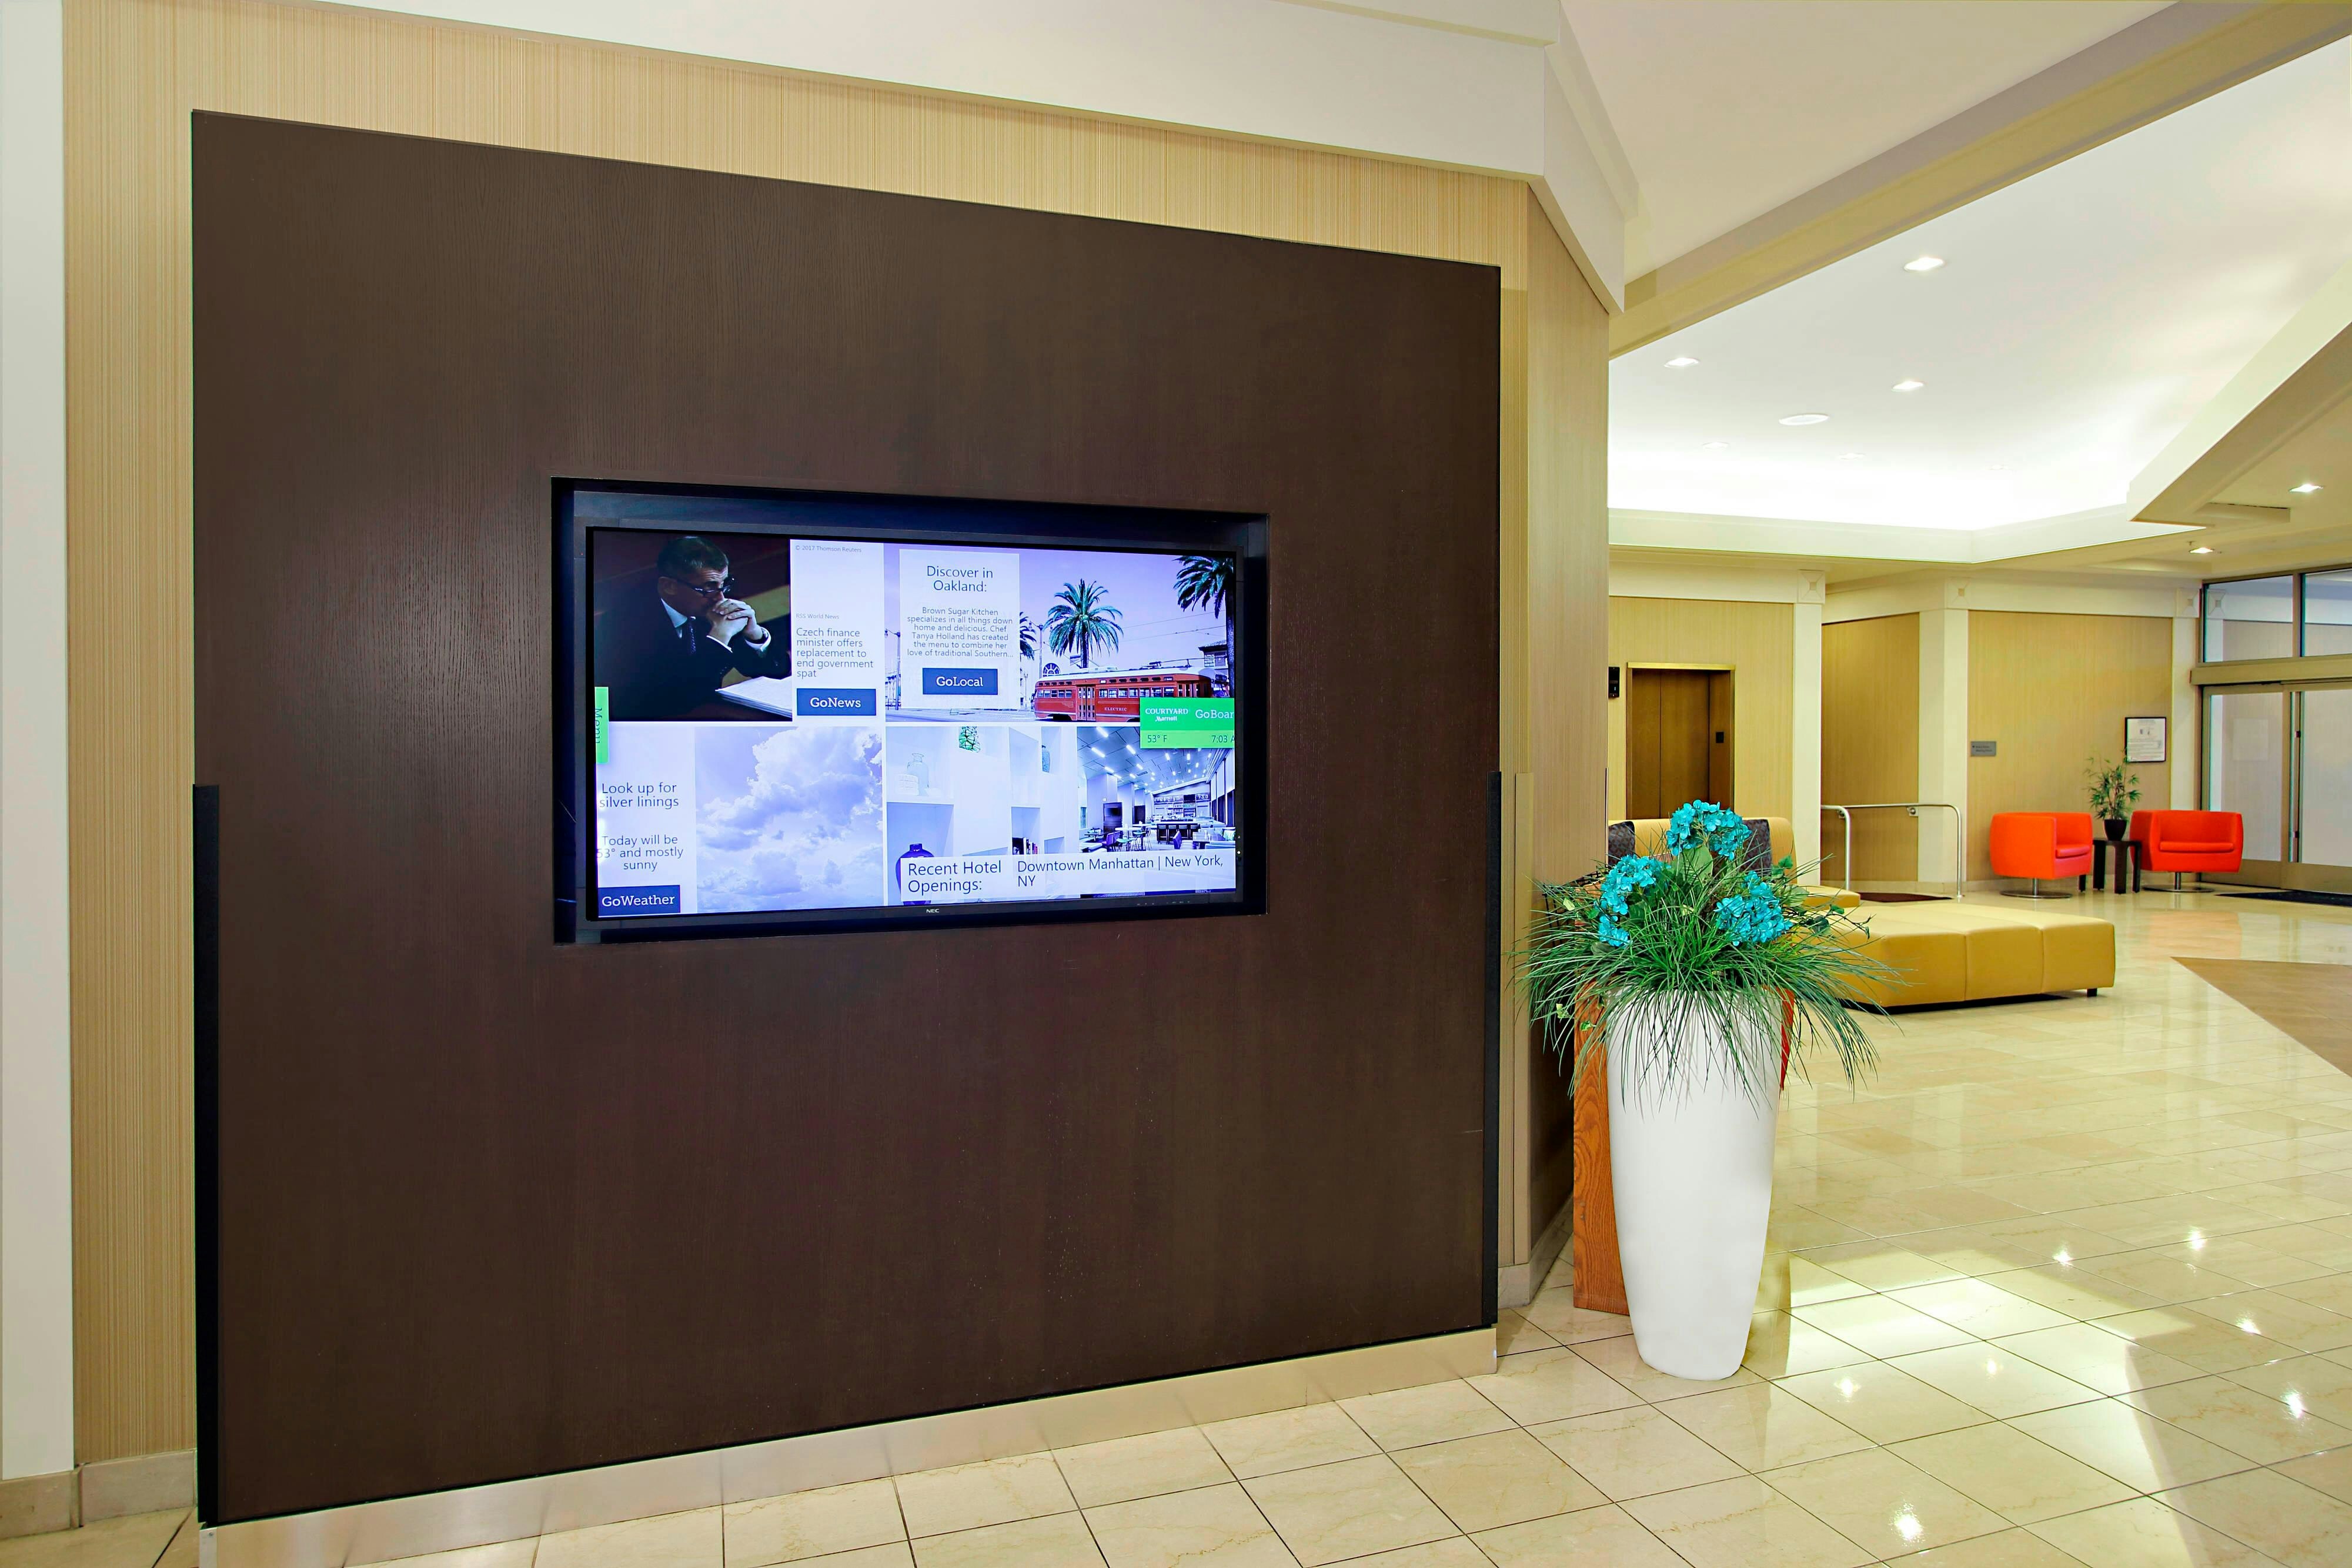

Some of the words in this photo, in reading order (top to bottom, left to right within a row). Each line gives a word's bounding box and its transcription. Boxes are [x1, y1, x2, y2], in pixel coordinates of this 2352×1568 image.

[927, 566, 978, 578] Discover
[983, 567, 993, 579] in
[934, 580, 987, 592] Oakland:
[922, 607, 946, 615] Brown
[948, 607, 970, 617] Sugar
[971, 608, 998, 616] Kitchen
[968, 617, 990, 626] things
[796, 627, 824, 637] Czech
[827, 627, 860, 637] finance
[912, 632, 934, 641] Tanya
[796, 637, 834, 647] minister
[837, 638, 863, 647] offers
[796, 648, 854, 659] replacement
[857, 650, 867, 658] to
[796, 658, 814, 667] end
[817, 660, 874, 670] government
[796, 670, 817, 680] spat
[936, 676, 984, 687] GoLocal
[810, 697, 861, 708] GoNews
[1147, 735, 1161, 743] 53°
[1211, 735, 1228, 743] 7:03
[602, 782, 633, 794] Look
[638, 784, 654, 796] up
[659, 782, 677, 793] for
[599, 796, 633, 808] silver
[637, 795, 679, 810] linings
[602, 835, 637, 848] Today
[641, 834, 660, 845] will
[664, 834, 678, 844] be
[620, 847, 641, 858] and
[646, 846, 684, 859] mostly
[623, 861, 658, 872] sunny
[908, 862, 958, 875] Recent
[964, 860, 1001, 874] Hotel
[1018, 860, 1084, 872] Downtown
[1089, 857, 1154, 870] Manhattan
[1165, 855, 1191, 868] New
[1194, 854, 1223, 867] York,
[908, 878, 982, 895] Openings:
[1018, 875, 1035, 887] NY
[602, 895, 675, 907] GoWeather
